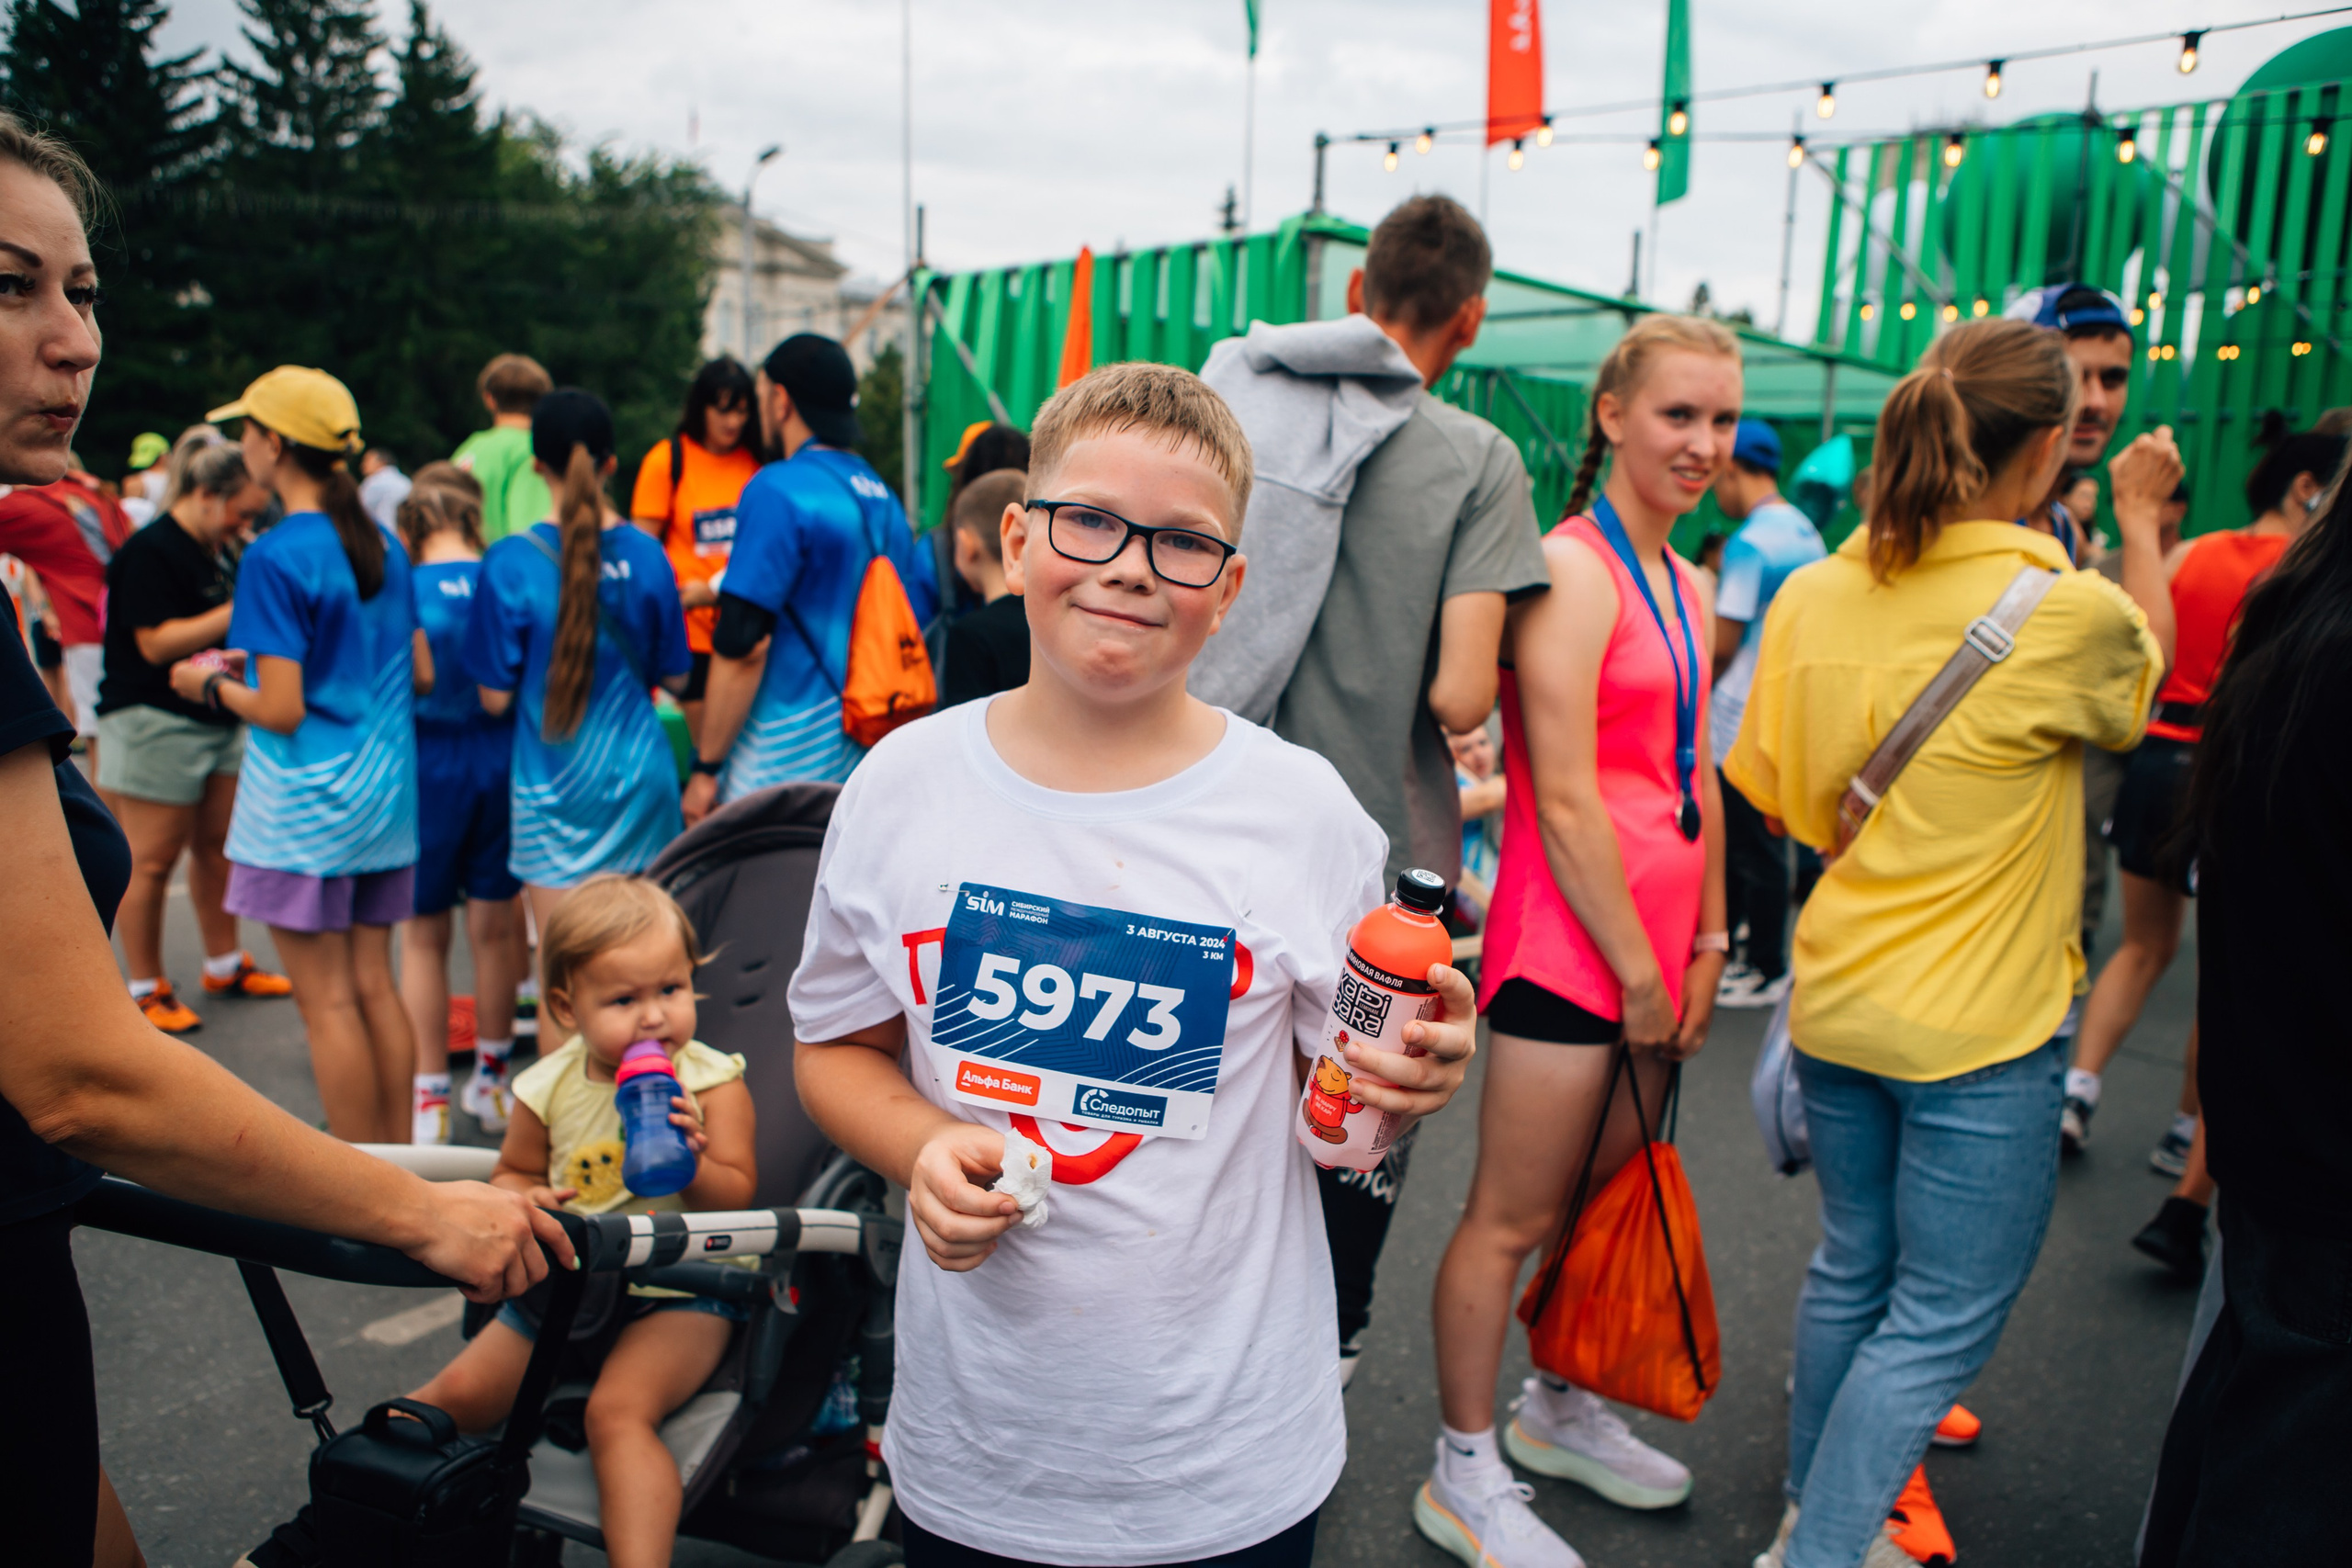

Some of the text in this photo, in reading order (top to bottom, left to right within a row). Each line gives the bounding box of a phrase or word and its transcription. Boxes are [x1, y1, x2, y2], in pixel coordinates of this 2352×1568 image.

[1012, 901, 1050, 914] СИБИРСКИЙ
[1010, 911, 1048, 925] МАРАФОН
[1126, 924, 1226, 949] 3 АВГУСТА 2024
[1203, 951, 1209, 959] 3
[1374, 971, 1403, 988] ВАФЛЯ
[967, 953, 1185, 1051] 5973
[961, 1070, 1033, 1095] Альфа Банк
[1090, 1098, 1160, 1119] Следопыт
